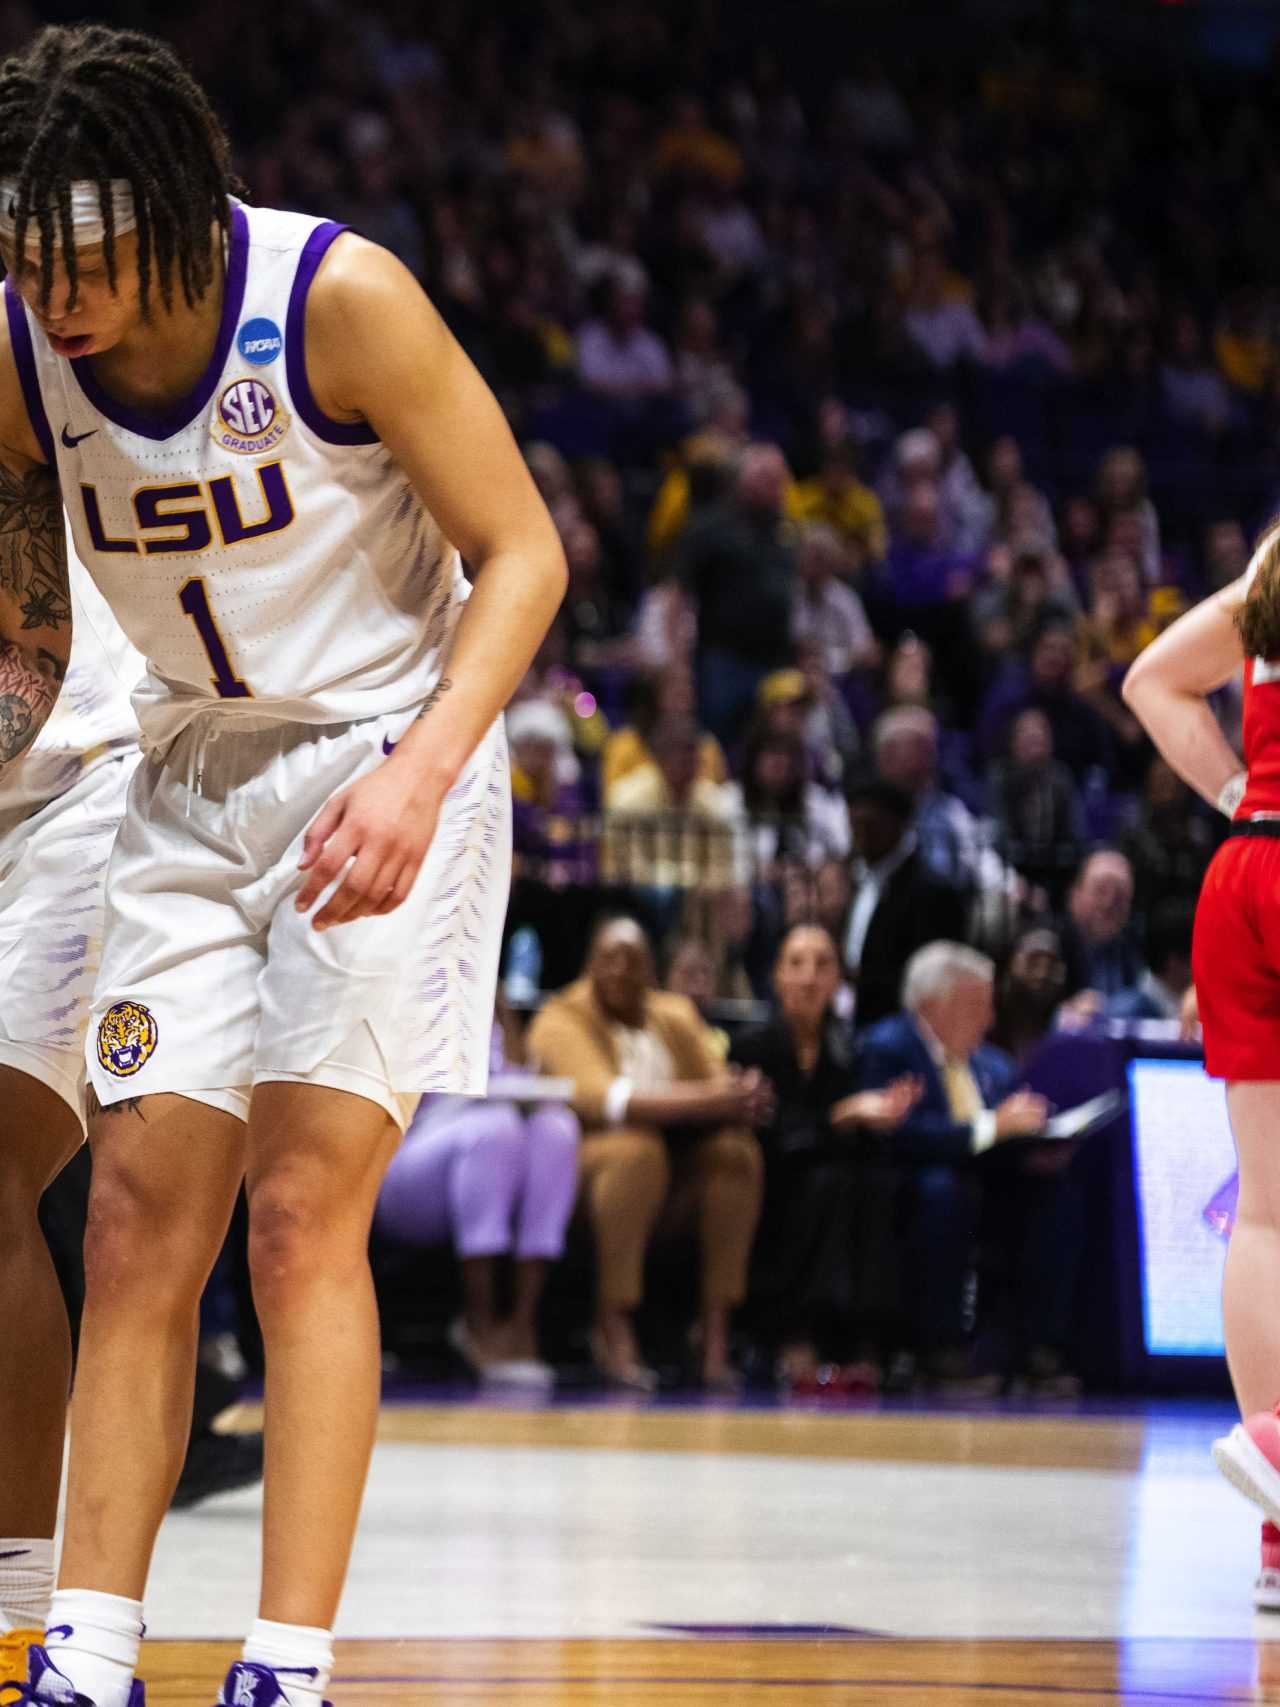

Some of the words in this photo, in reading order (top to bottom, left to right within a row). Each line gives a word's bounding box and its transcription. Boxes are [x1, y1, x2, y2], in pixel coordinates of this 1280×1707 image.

[244, 338, 281, 354] NCAA
[222, 381, 274, 434] SEC
[222, 426, 285, 451] GRADUATE
[79, 461, 297, 555] LSU
[179, 577, 254, 699] 1
